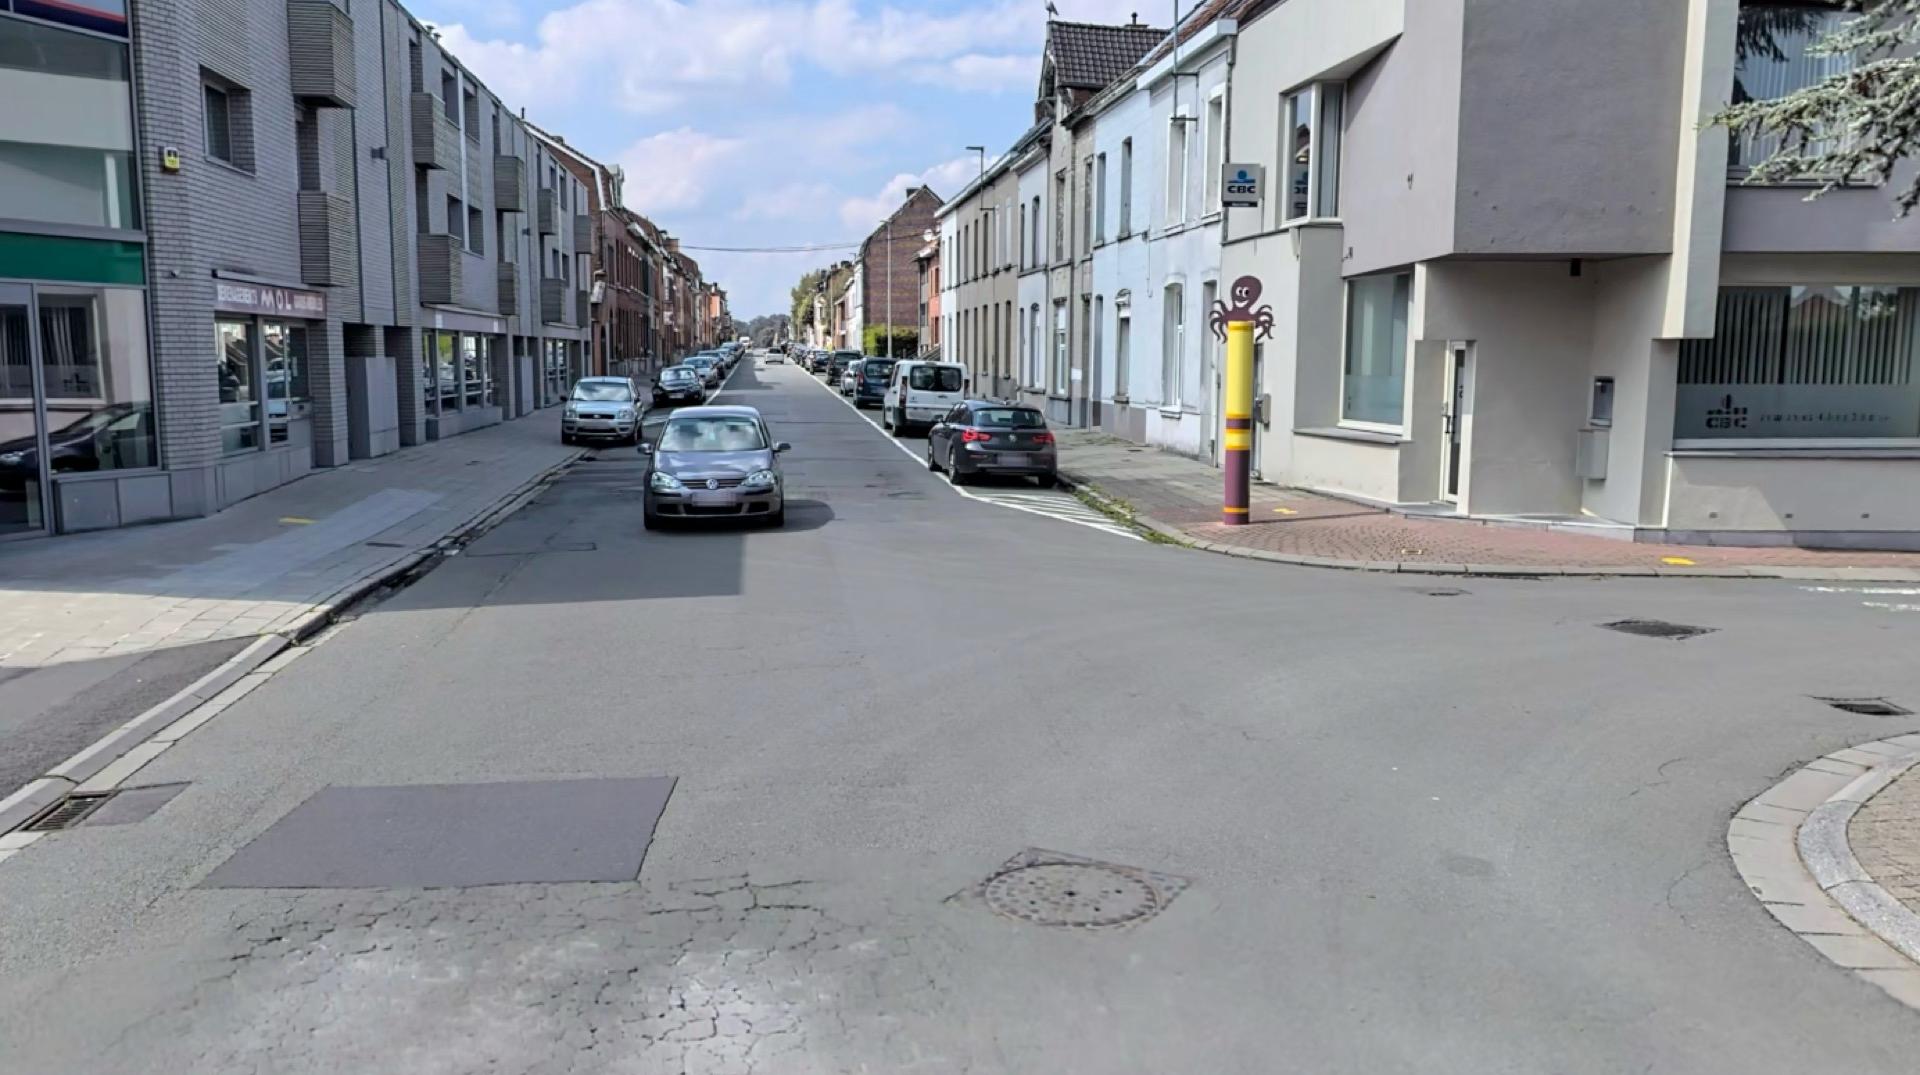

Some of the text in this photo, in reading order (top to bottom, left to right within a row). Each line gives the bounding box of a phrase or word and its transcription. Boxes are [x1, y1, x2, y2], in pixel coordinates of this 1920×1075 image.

[1227, 185, 1256, 194] CBC
[260, 289, 292, 310] MOL
[1705, 416, 1748, 429] CBC
